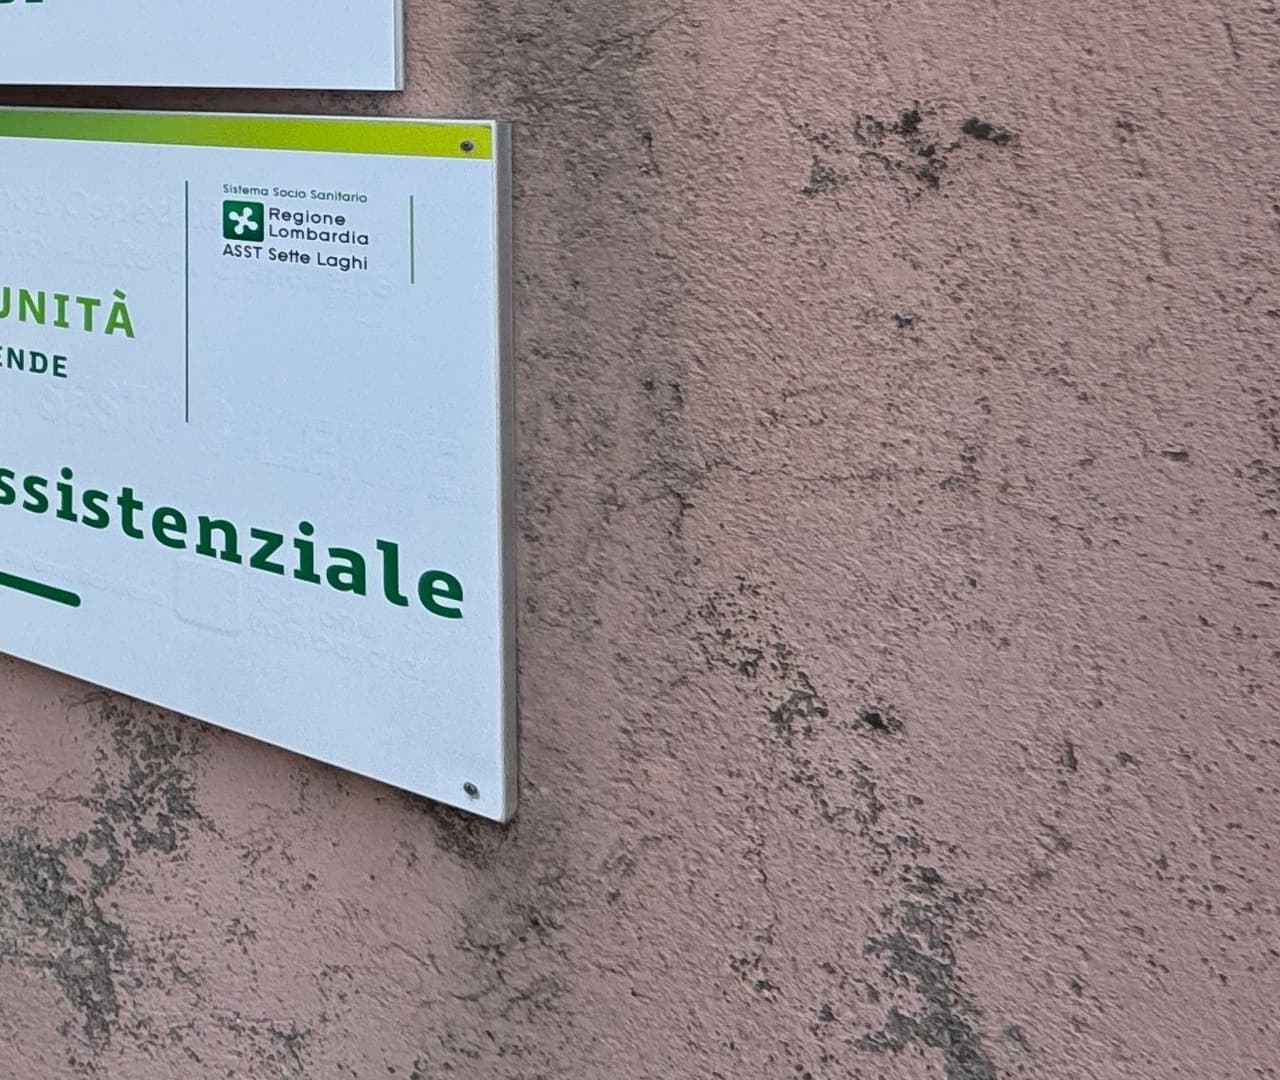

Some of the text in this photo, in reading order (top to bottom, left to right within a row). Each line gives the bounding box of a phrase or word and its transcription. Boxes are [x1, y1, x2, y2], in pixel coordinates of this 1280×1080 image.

[223, 184, 368, 203] Sistema Socio Sanitario
[269, 207, 346, 226] Regione
[269, 224, 369, 246] Lombardia
[223, 243, 368, 272] ASST Sette Laghi
